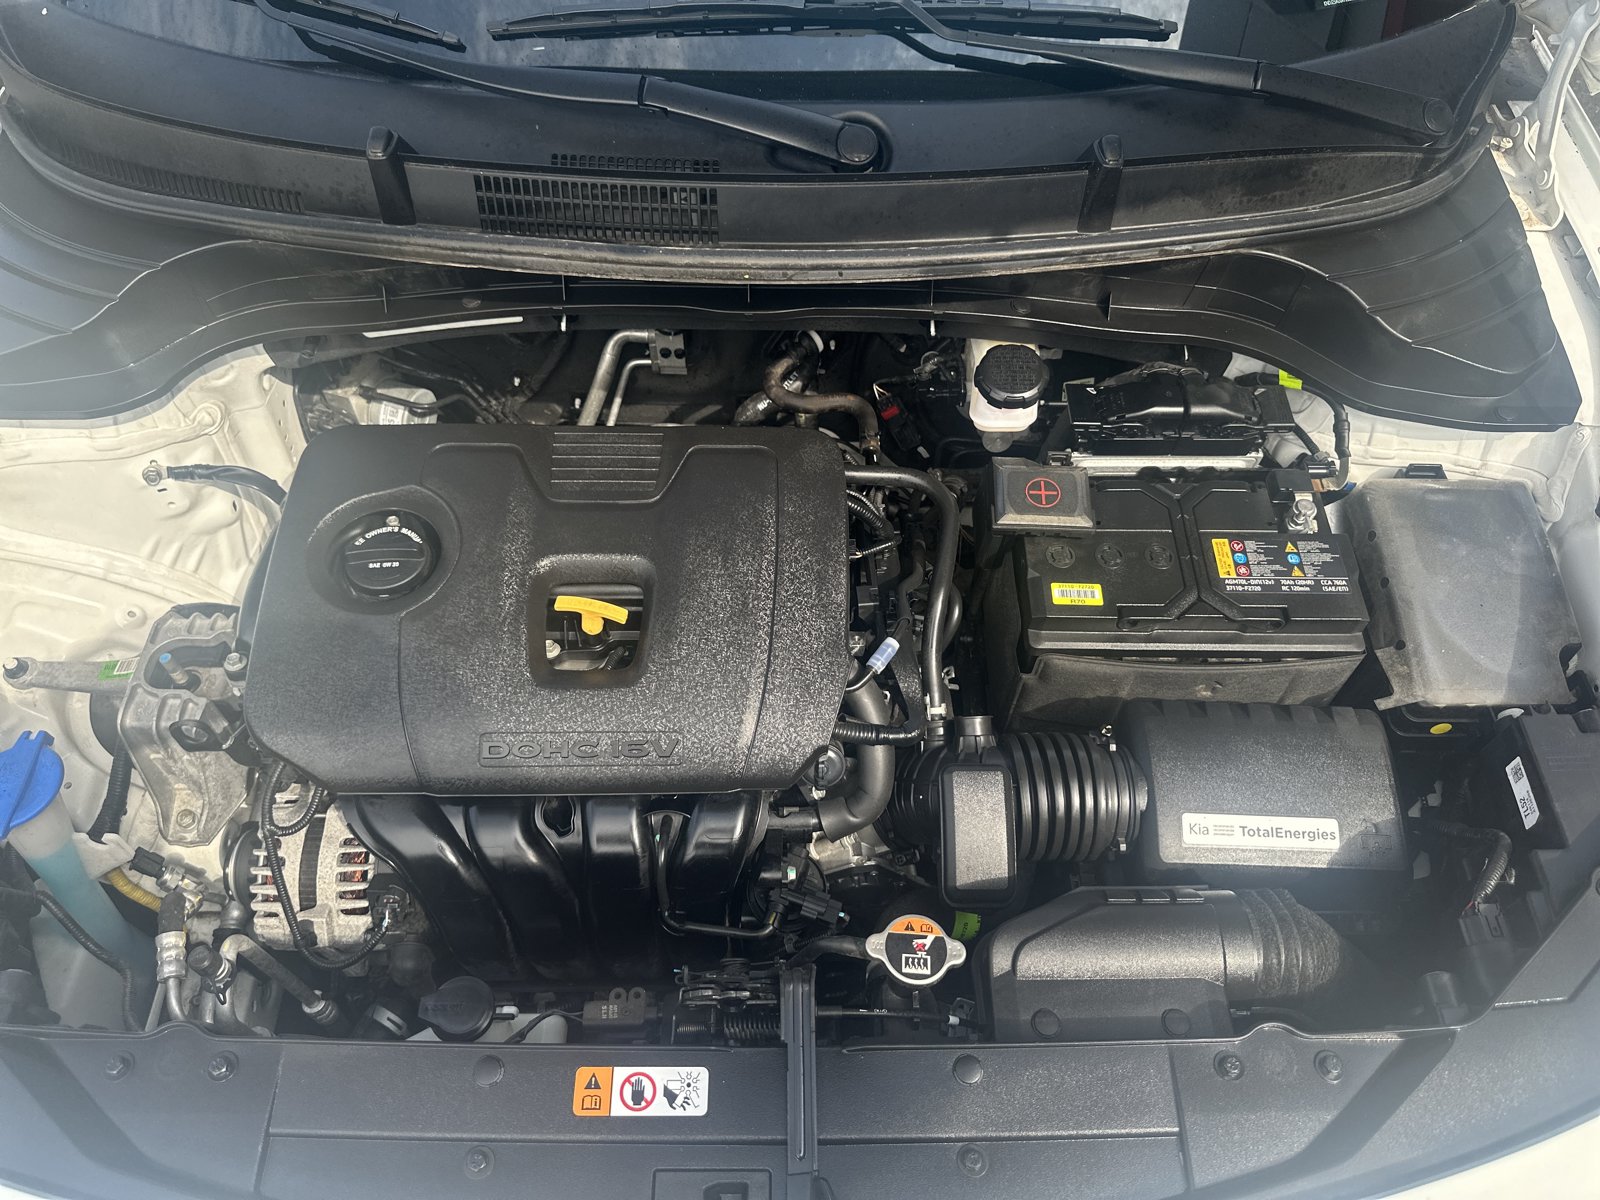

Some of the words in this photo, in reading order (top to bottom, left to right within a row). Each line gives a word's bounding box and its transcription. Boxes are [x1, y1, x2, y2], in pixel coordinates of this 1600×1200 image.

[365, 526, 400, 539] OWNER'S
[482, 739, 600, 760] DOHC
[611, 738, 679, 758] 16V
[1189, 823, 1210, 836] Kia
[1238, 825, 1337, 842] TotalEnergies
